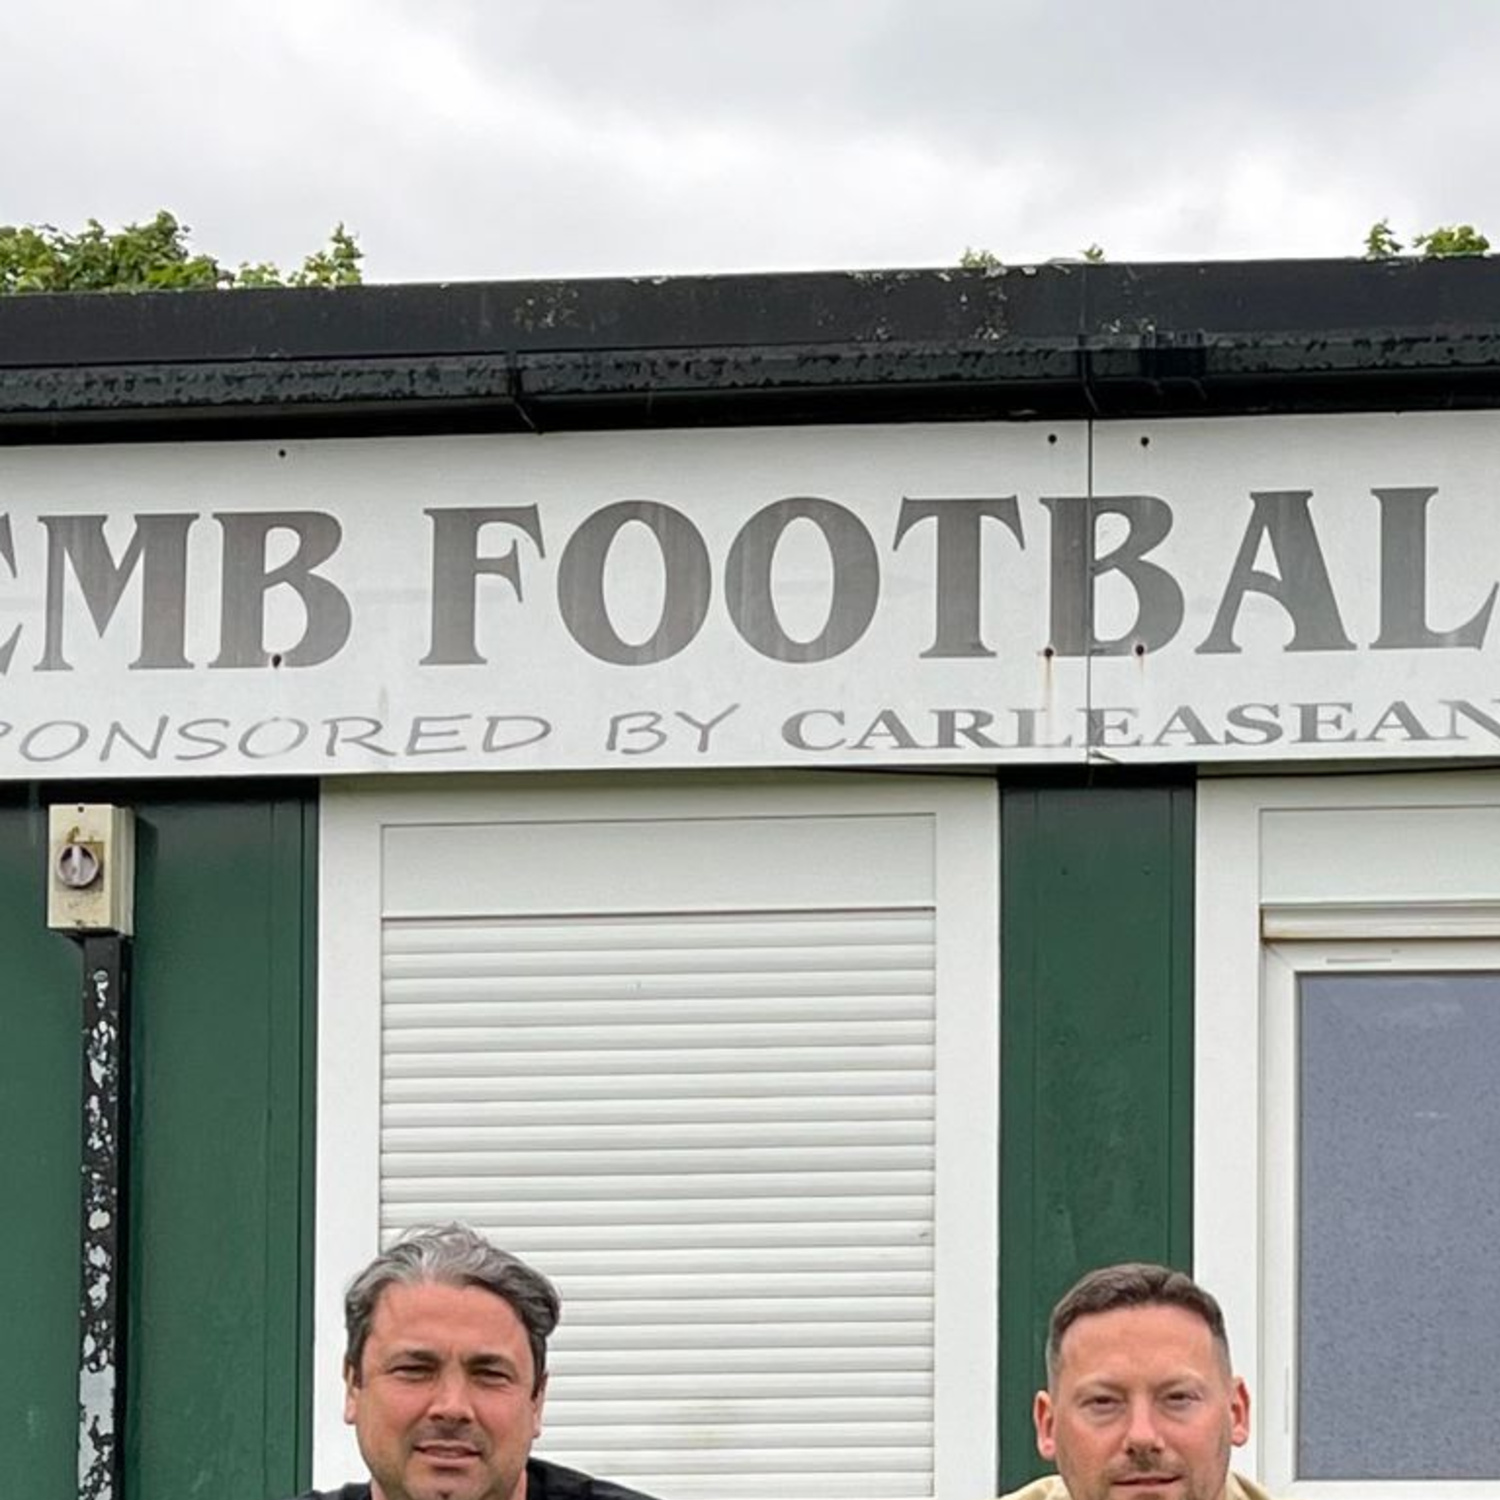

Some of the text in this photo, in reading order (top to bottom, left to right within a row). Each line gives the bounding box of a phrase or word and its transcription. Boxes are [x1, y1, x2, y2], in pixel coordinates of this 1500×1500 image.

[0, 511, 352, 678] MB
[0, 714, 553, 763] ONSORED
[605, 703, 741, 756] BY
